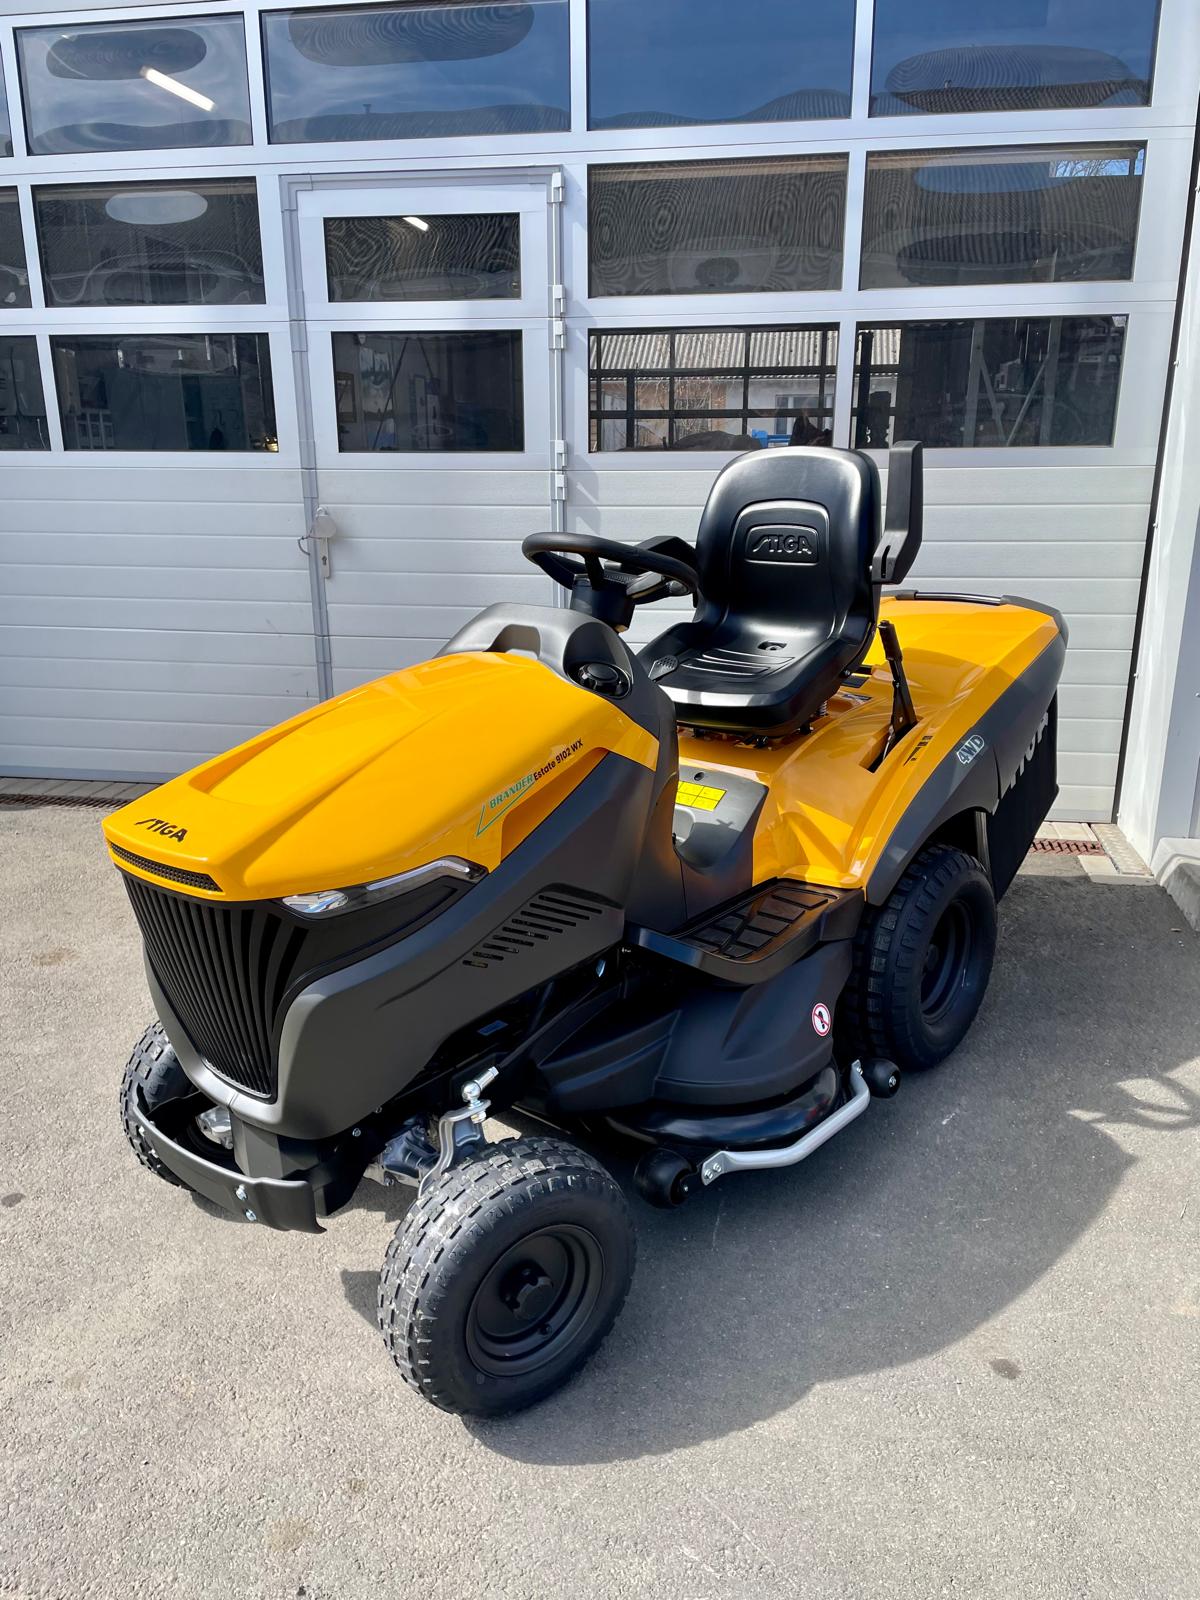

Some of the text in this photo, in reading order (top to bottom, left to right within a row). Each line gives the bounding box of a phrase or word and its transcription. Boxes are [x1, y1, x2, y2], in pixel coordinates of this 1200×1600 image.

[753, 534, 813, 555] STIGA
[956, 735, 985, 765] 4WD
[489, 738, 584, 809] BRANDER Estate 9102 WX
[134, 818, 188, 842] STIGA
